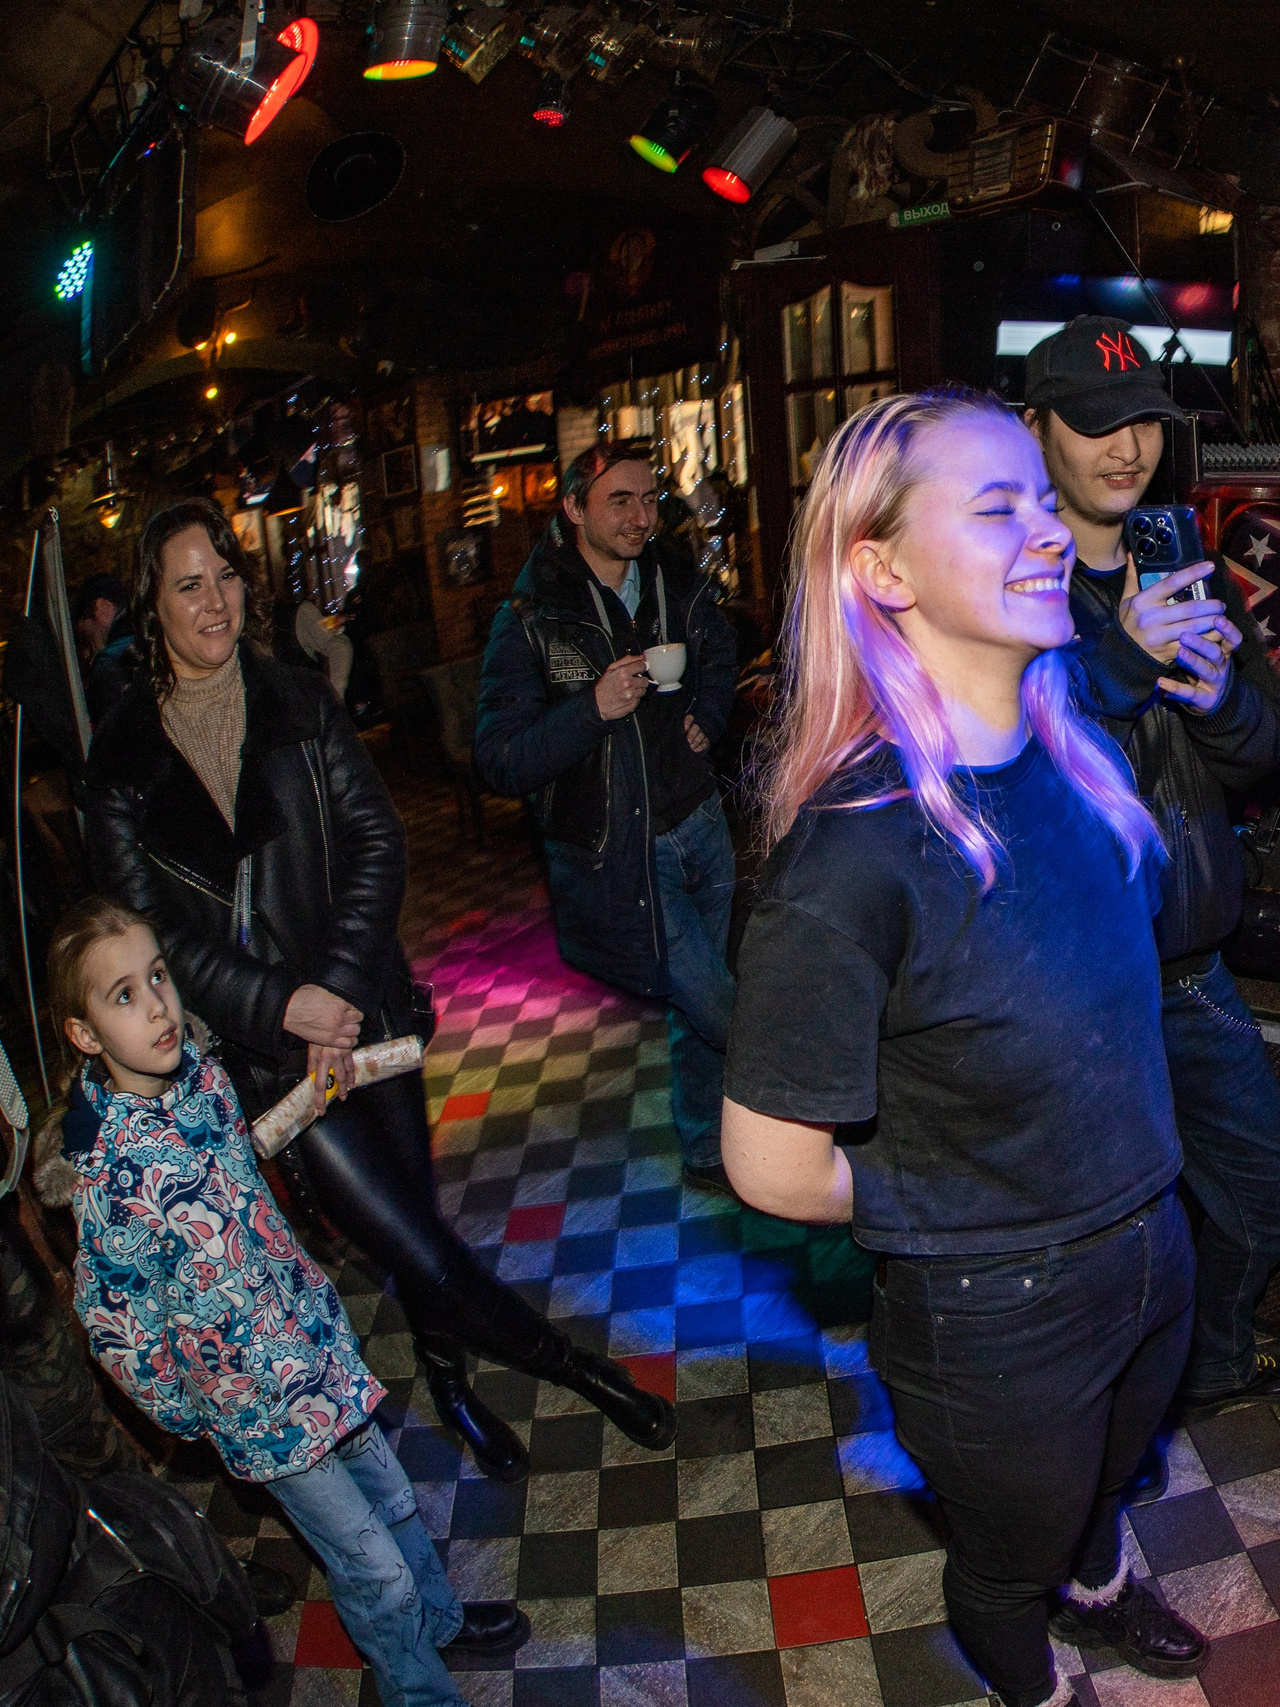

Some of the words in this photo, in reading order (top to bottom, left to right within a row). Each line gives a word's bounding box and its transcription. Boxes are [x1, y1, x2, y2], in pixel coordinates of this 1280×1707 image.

[903, 202, 950, 220] ВЫХОД
[1095, 330, 1141, 371] NY
[554, 670, 589, 681] MEMBER
